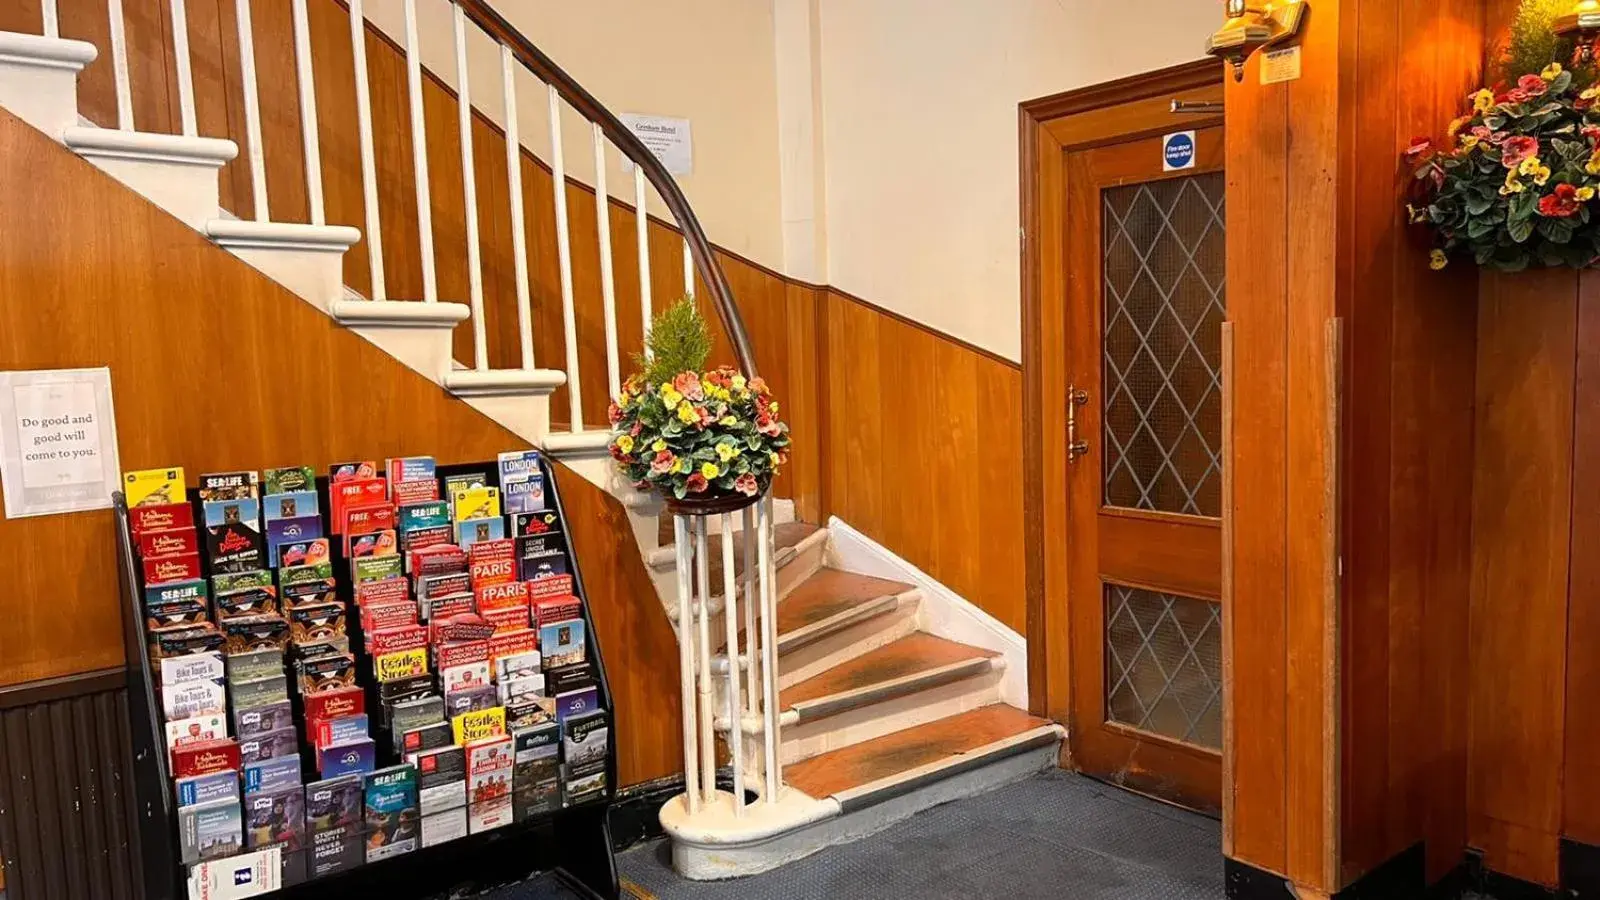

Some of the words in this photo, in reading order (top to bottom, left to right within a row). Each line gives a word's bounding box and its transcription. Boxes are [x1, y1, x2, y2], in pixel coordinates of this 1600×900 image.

[22, 418, 39, 427] Do
[41, 415, 69, 428] good
[72, 413, 93, 423] and
[33, 433, 61, 446] good
[64, 430, 85, 441] will
[25, 453, 56, 461] come
[58, 450, 70, 459] to
[72, 450, 97, 460] you.
[504, 458, 537, 473] LONDON
[207, 478, 224, 488] SEA
[226, 476, 242, 486] LIFE
[508, 482, 541, 495] LONDON
[343, 486, 360, 495] FREE
[350, 513, 368, 522] FREE
[411, 509, 426, 518] SEA
[426, 507, 440, 516] LIFE
[473, 562, 512, 579] PARIS
[161, 590, 180, 600] SEA
[180, 587, 198, 598] LIFE
[488, 583, 528, 598] PARIS
[381, 654, 423, 670] Beatles
[176, 668, 190, 678] Bike
[192, 666, 208, 675] Tours
[174, 694, 188, 704] Bike
[190, 692, 206, 701] Tours
[463, 714, 502, 728] Beatles
[374, 774, 391, 786] SEA
[392, 772, 406, 781] LIFE
[314, 827, 346, 840] STORIES
[315, 841, 340, 852] NEVER
[316, 846, 345, 859] FORGET
